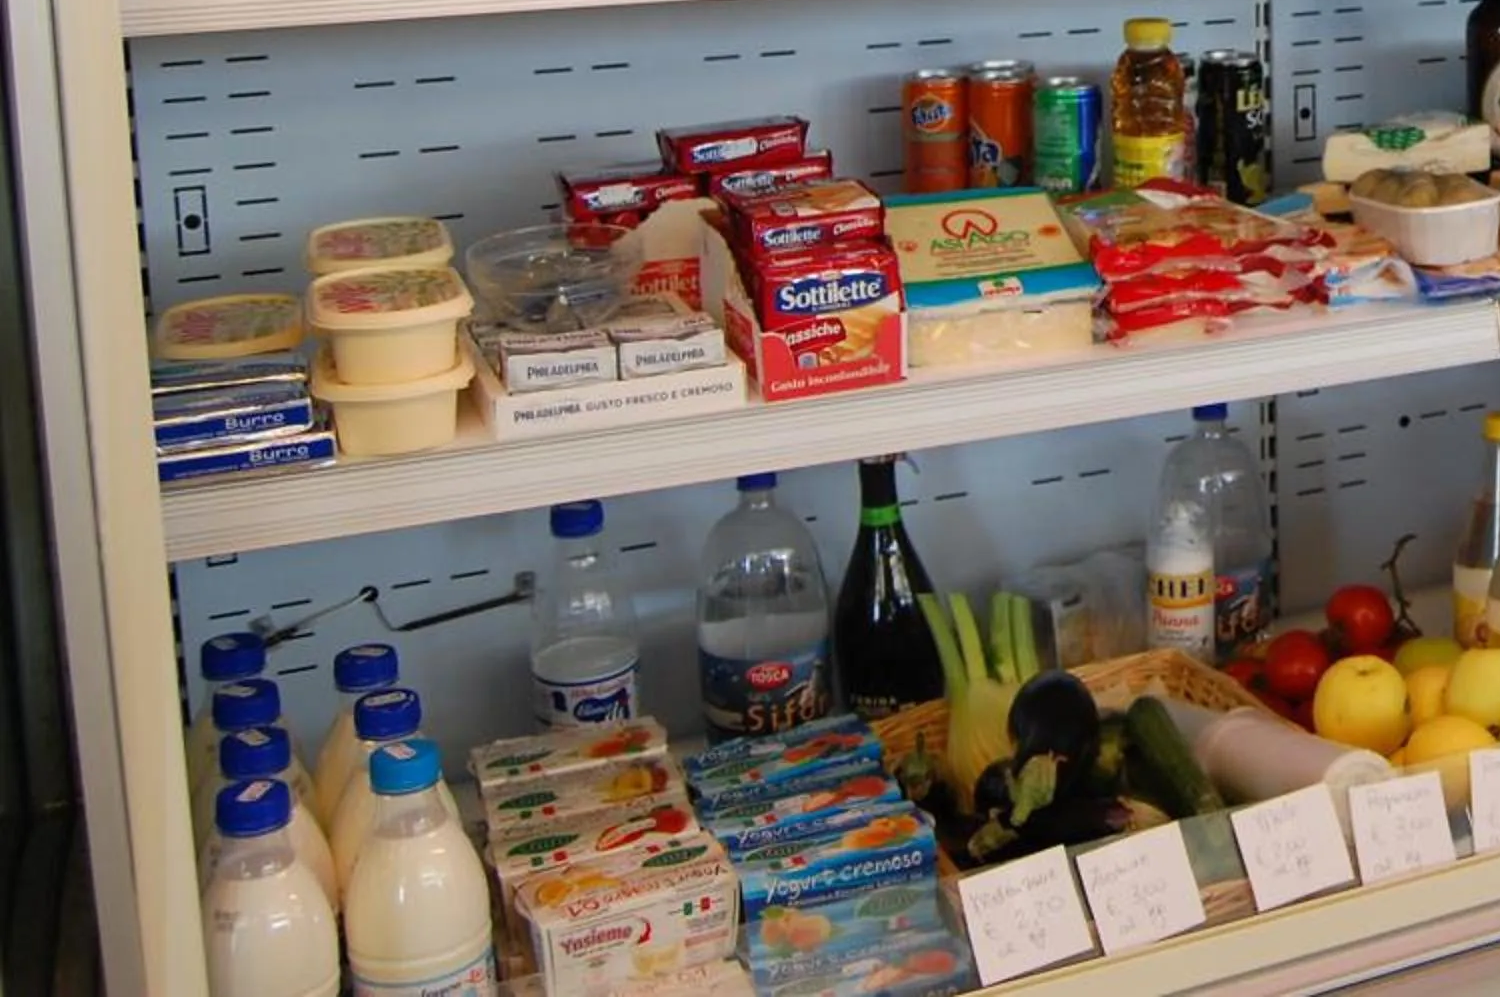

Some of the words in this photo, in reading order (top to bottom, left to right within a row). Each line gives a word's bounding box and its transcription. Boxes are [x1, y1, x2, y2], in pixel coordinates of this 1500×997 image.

[780, 280, 883, 311] Sottilette
[784, 322, 842, 347] lassiche
[635, 347, 705, 367] PHILADELPHIA
[527, 362, 599, 380] PHILADELPHIA
[513, 404, 581, 423] PHILADELPHIA
[585, 399, 623, 412] GUSTO
[625, 391, 669, 406] FRESCO
[680, 382, 733, 399] CREMOSO
[224, 411, 286, 430] Burro
[249, 445, 310, 463] Burro
